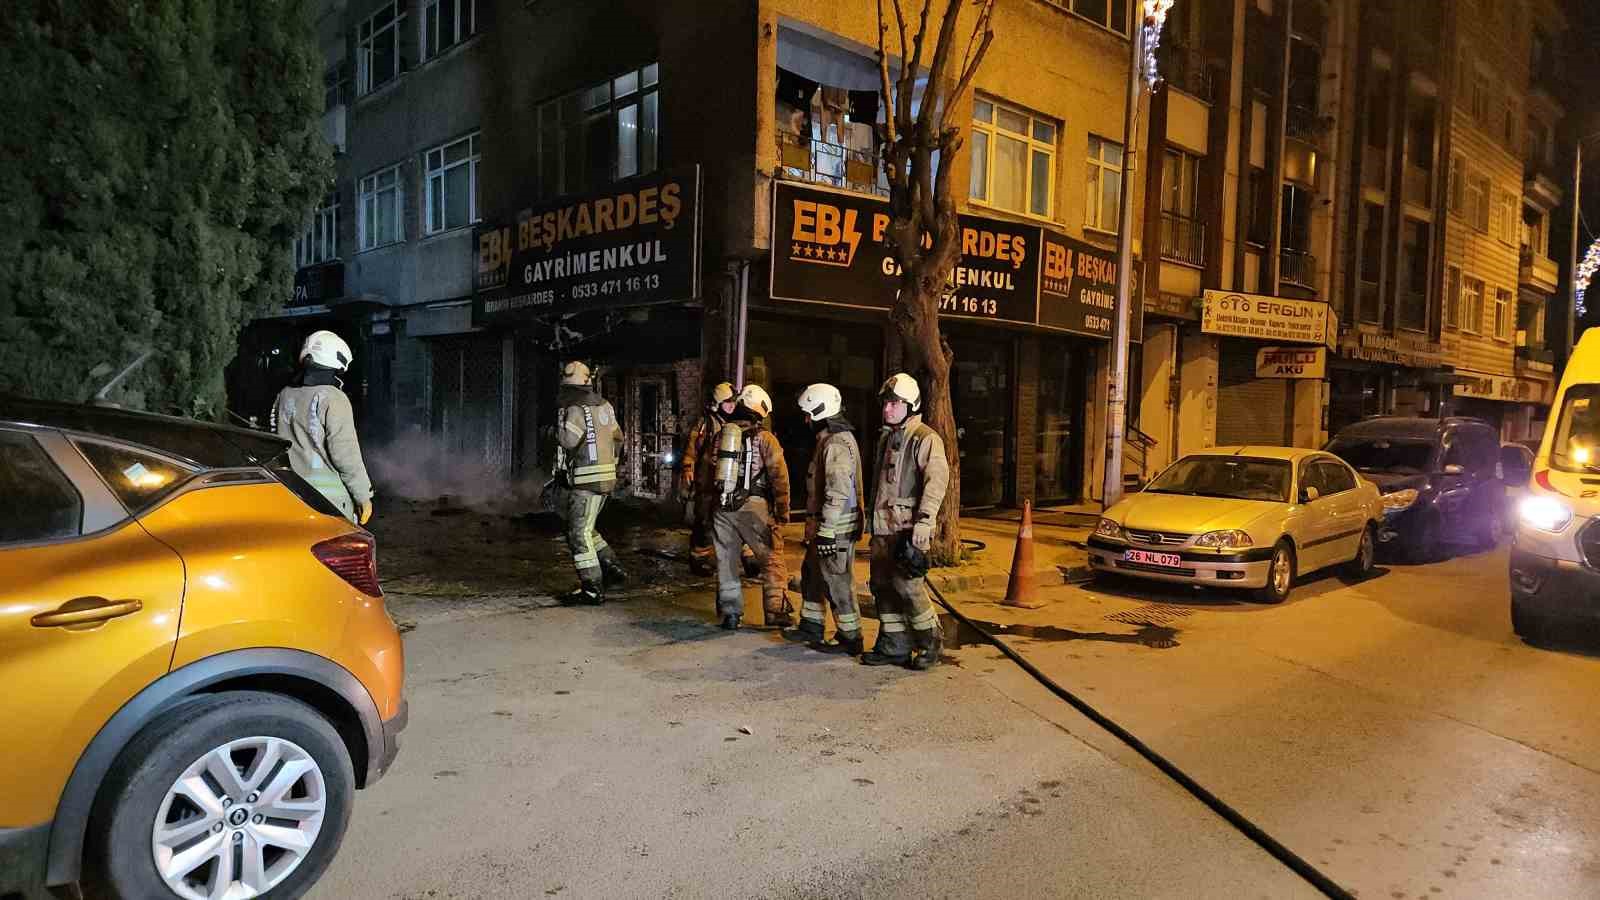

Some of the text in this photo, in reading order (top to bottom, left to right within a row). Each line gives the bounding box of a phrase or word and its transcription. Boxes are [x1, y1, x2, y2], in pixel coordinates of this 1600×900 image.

[519, 183, 681, 252] BEŞKARDEŞ
[873, 213, 1026, 269] BRDEŞ
[524, 240, 667, 284] GAYRİMENKUL
[1077, 253, 1116, 286] BEŞKA
[572, 284, 598, 299] 0533
[600, 281, 621, 295] 471
[627, 278, 641, 291] 16
[645, 274, 660, 289] 13
[961, 297, 978, 312] 16
[981, 299, 997, 315] 13
[1130, 551, 1179, 566] 26 NL 079
